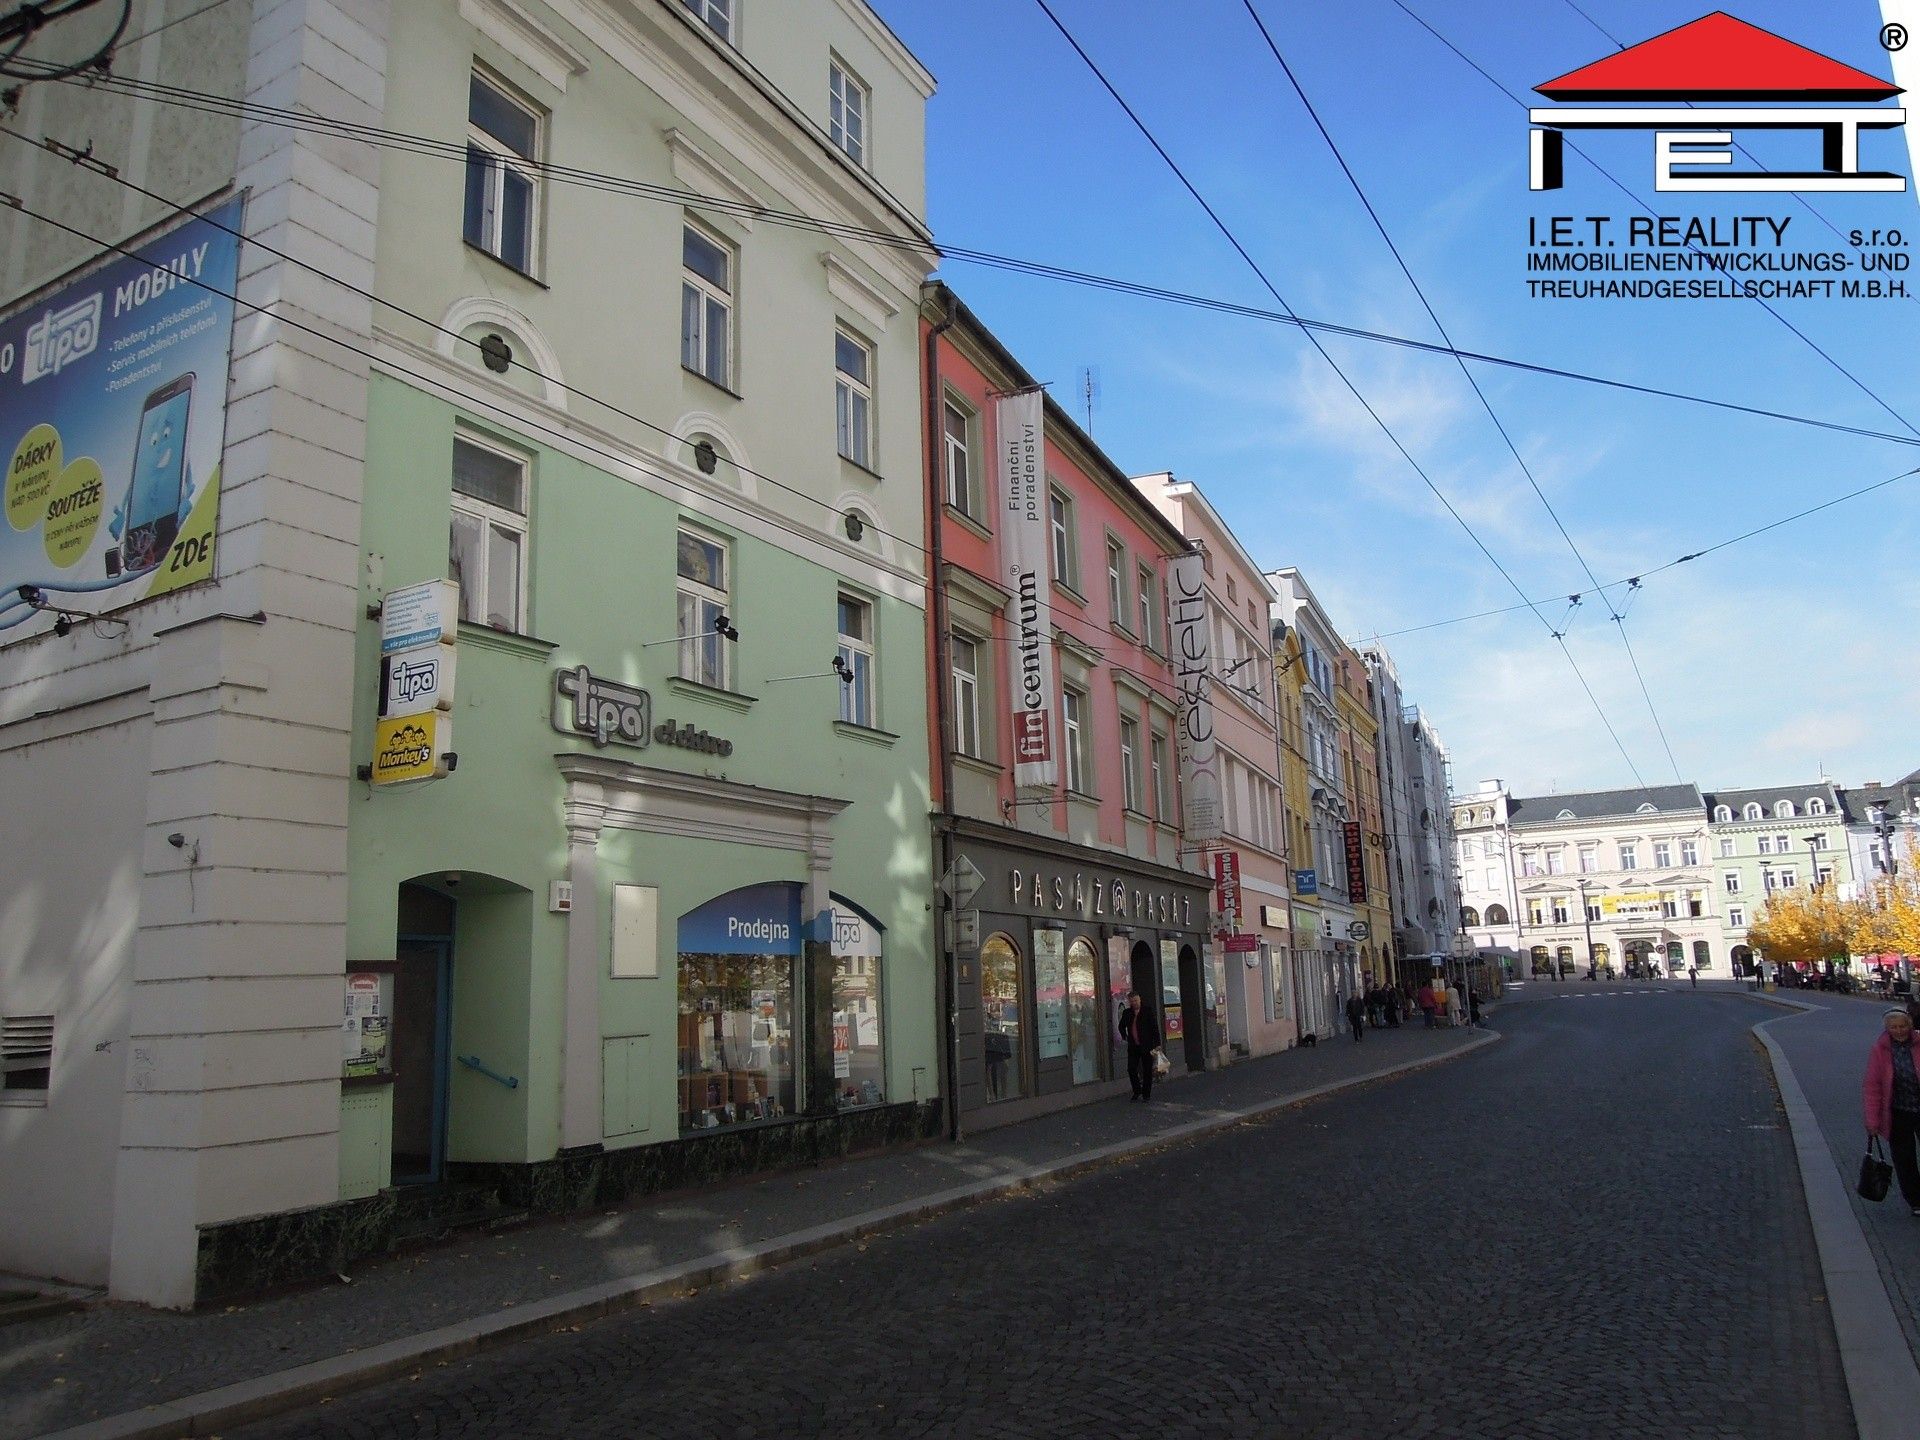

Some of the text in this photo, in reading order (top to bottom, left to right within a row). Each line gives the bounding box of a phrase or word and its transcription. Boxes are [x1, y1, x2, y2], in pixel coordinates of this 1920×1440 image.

[114, 242, 208, 319] MOBILY
[114, 329, 148, 352] Telefony
[112, 352, 136, 373] Servis
[14, 439, 57, 475] DÁRKY
[1007, 440, 1020, 511] Finanční
[1022, 423, 1039, 521] poradenství
[47, 478, 102, 521] SOUTĚŽE
[170, 531, 213, 573] ZDE
[393, 661, 435, 701] tipa
[559, 665, 646, 749] tipa
[1177, 695, 1189, 763] STUDIO
[379, 746, 431, 768] Monkey's
[1222, 853, 1233, 880] SEX
[1013, 869, 1191, 926] PASÁŽ PASÁŽ
[728, 916, 790, 944] Prodejna
[831, 907, 861, 951] tipa
